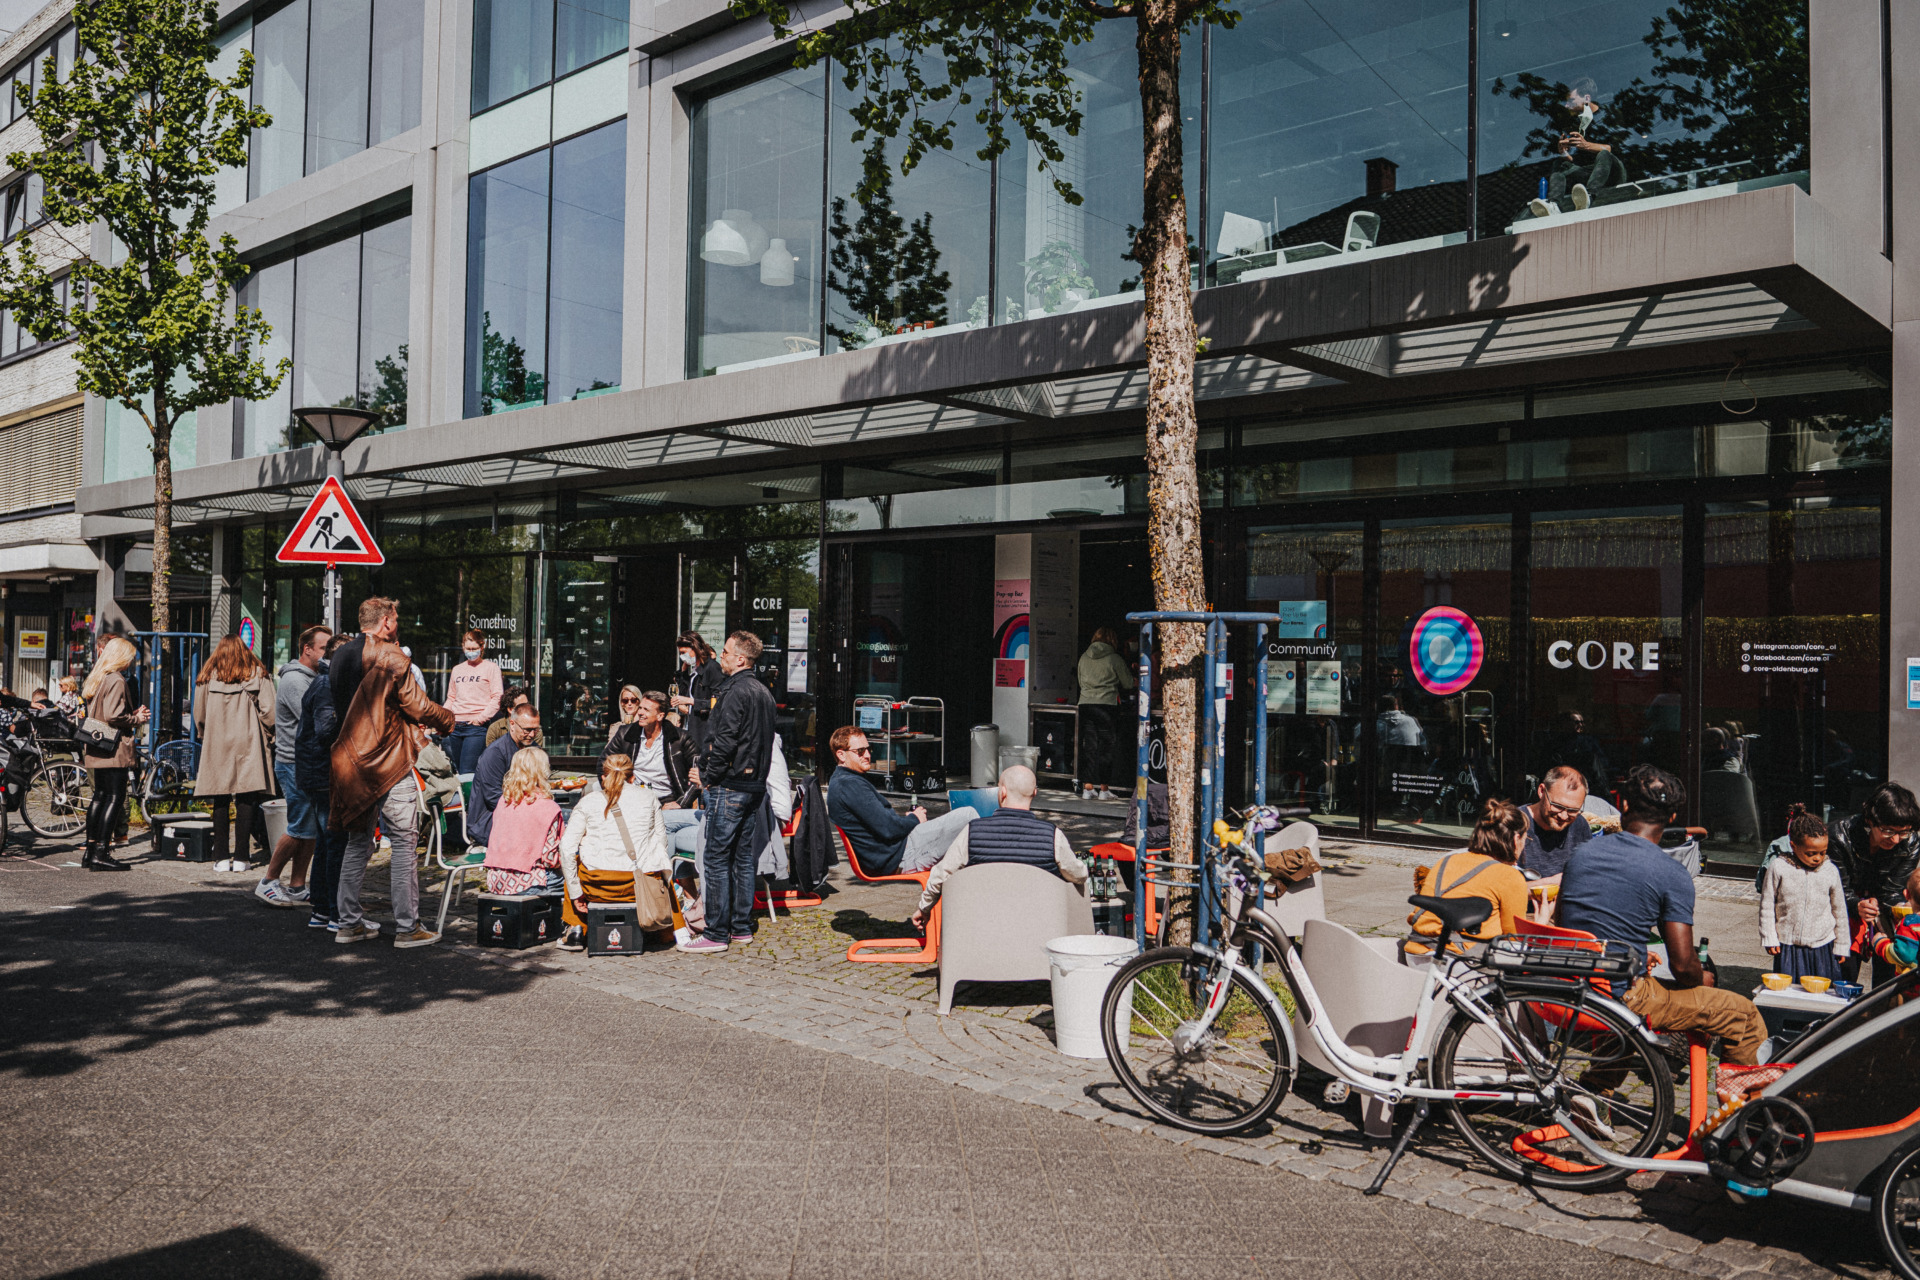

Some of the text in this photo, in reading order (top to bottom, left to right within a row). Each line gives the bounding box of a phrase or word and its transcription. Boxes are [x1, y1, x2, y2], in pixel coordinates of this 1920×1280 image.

[752, 597, 782, 610] CORE
[469, 613, 517, 632] Something
[488, 635, 495, 649] is
[497, 635, 506, 649] in
[1268, 643, 1338, 658] Community
[1547, 640, 1659, 670] CORE
[1753, 665, 1819, 674] core-oldenburg.de
[456, 675, 481, 683] CORE
